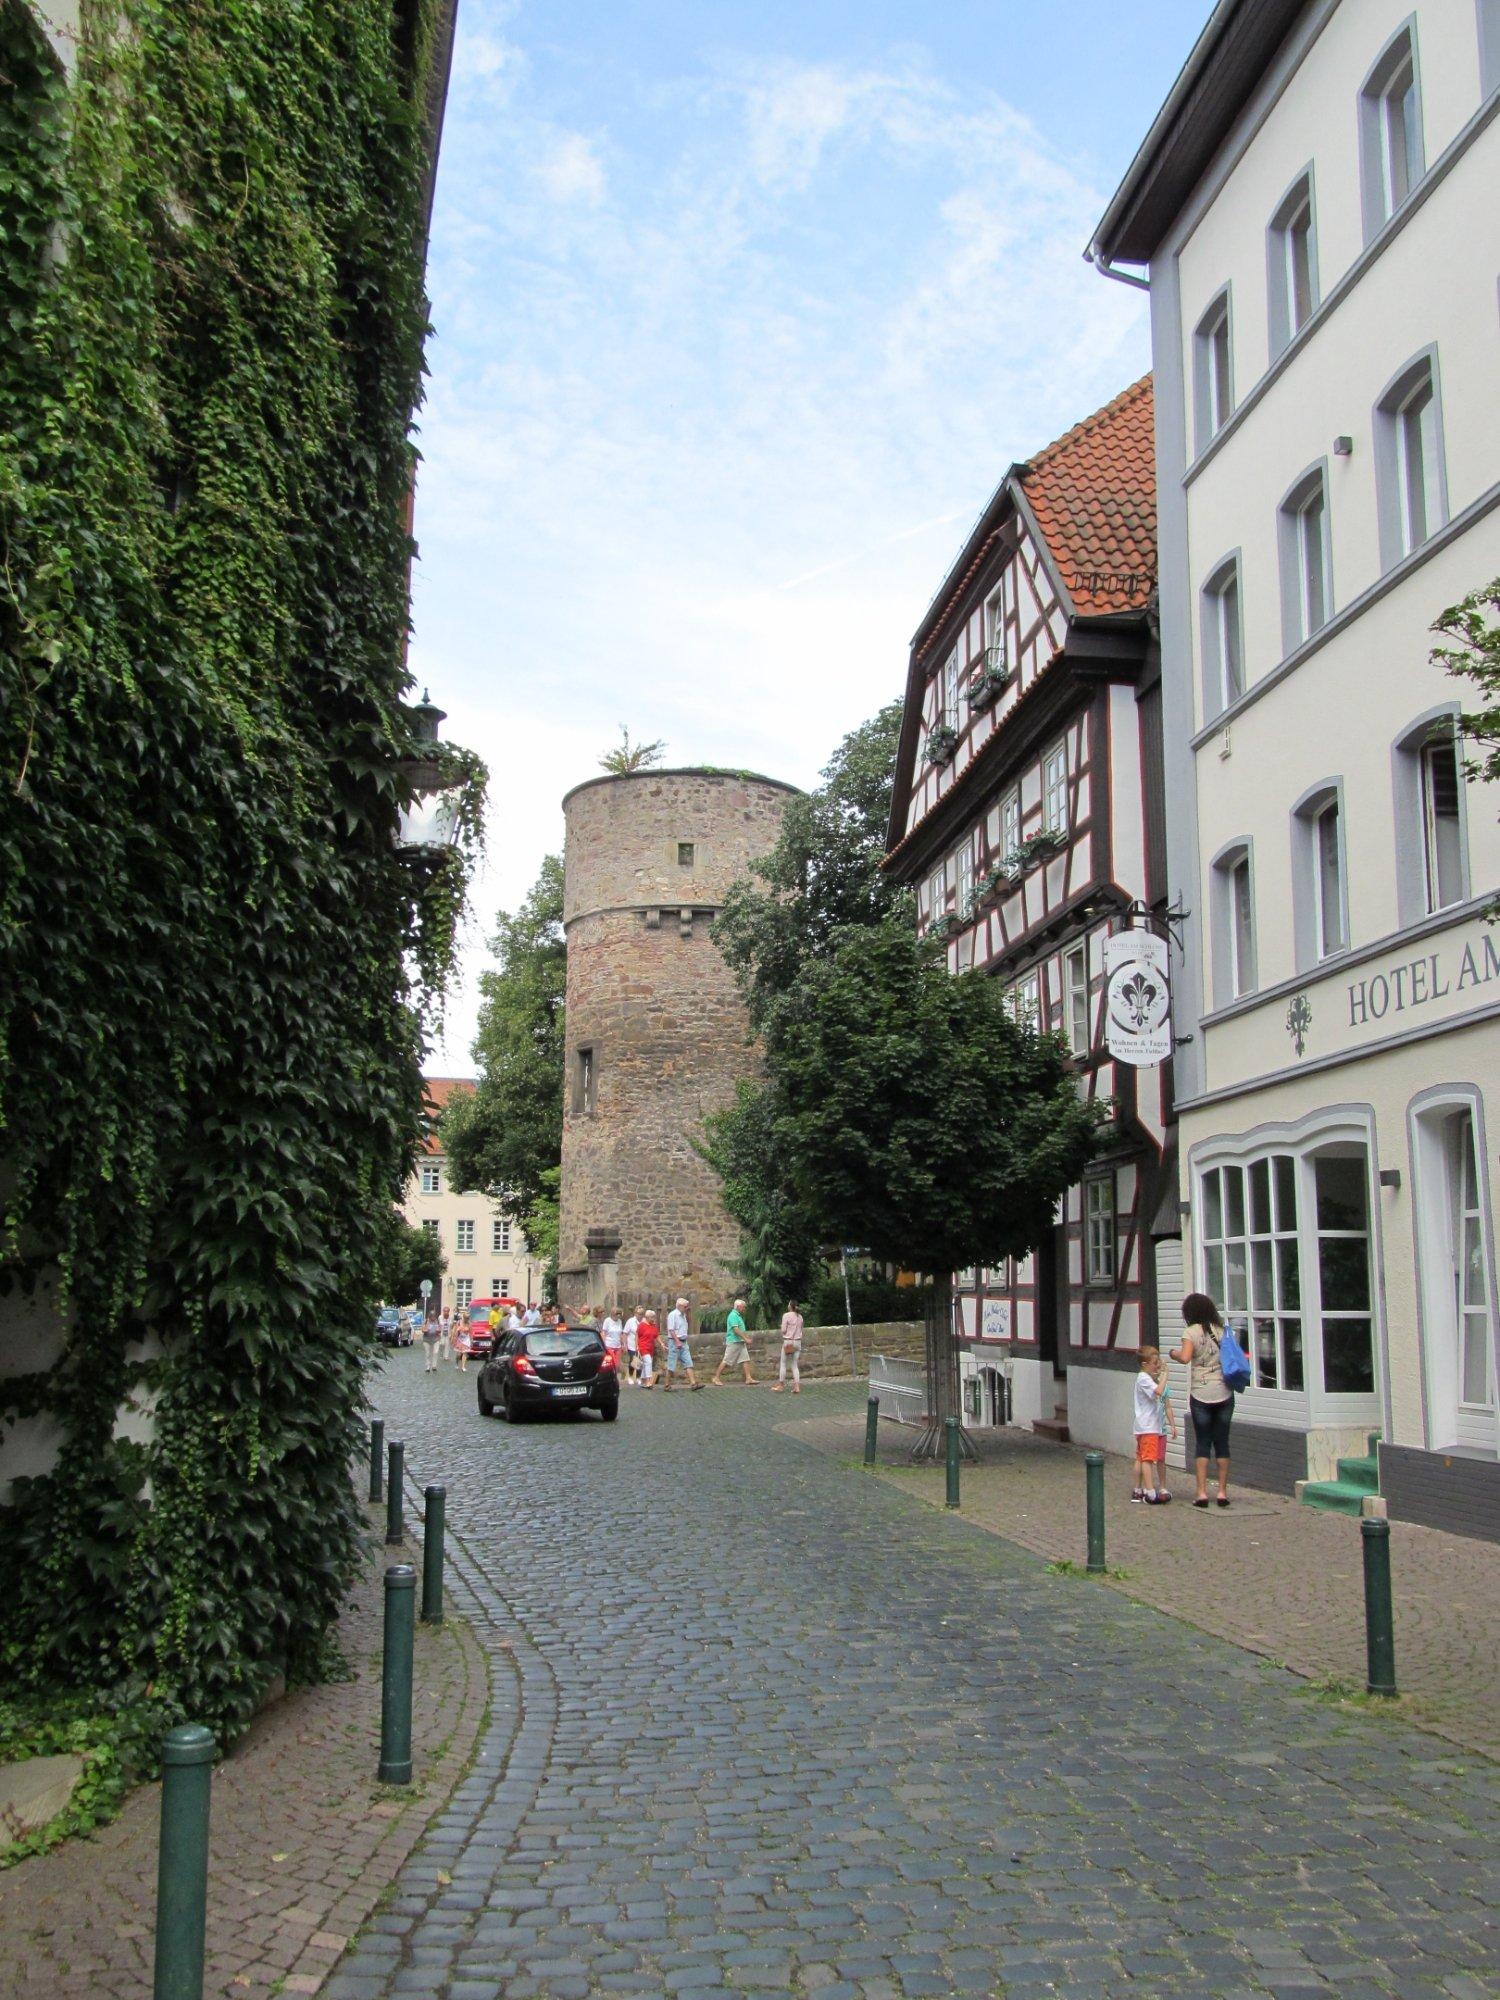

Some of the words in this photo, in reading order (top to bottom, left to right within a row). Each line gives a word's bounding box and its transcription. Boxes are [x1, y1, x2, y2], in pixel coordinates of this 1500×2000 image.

[1347, 953, 1450, 1027] HOTEL
[1456, 934, 1500, 991] AM
[1111, 1039, 1138, 1047] Wohnen
